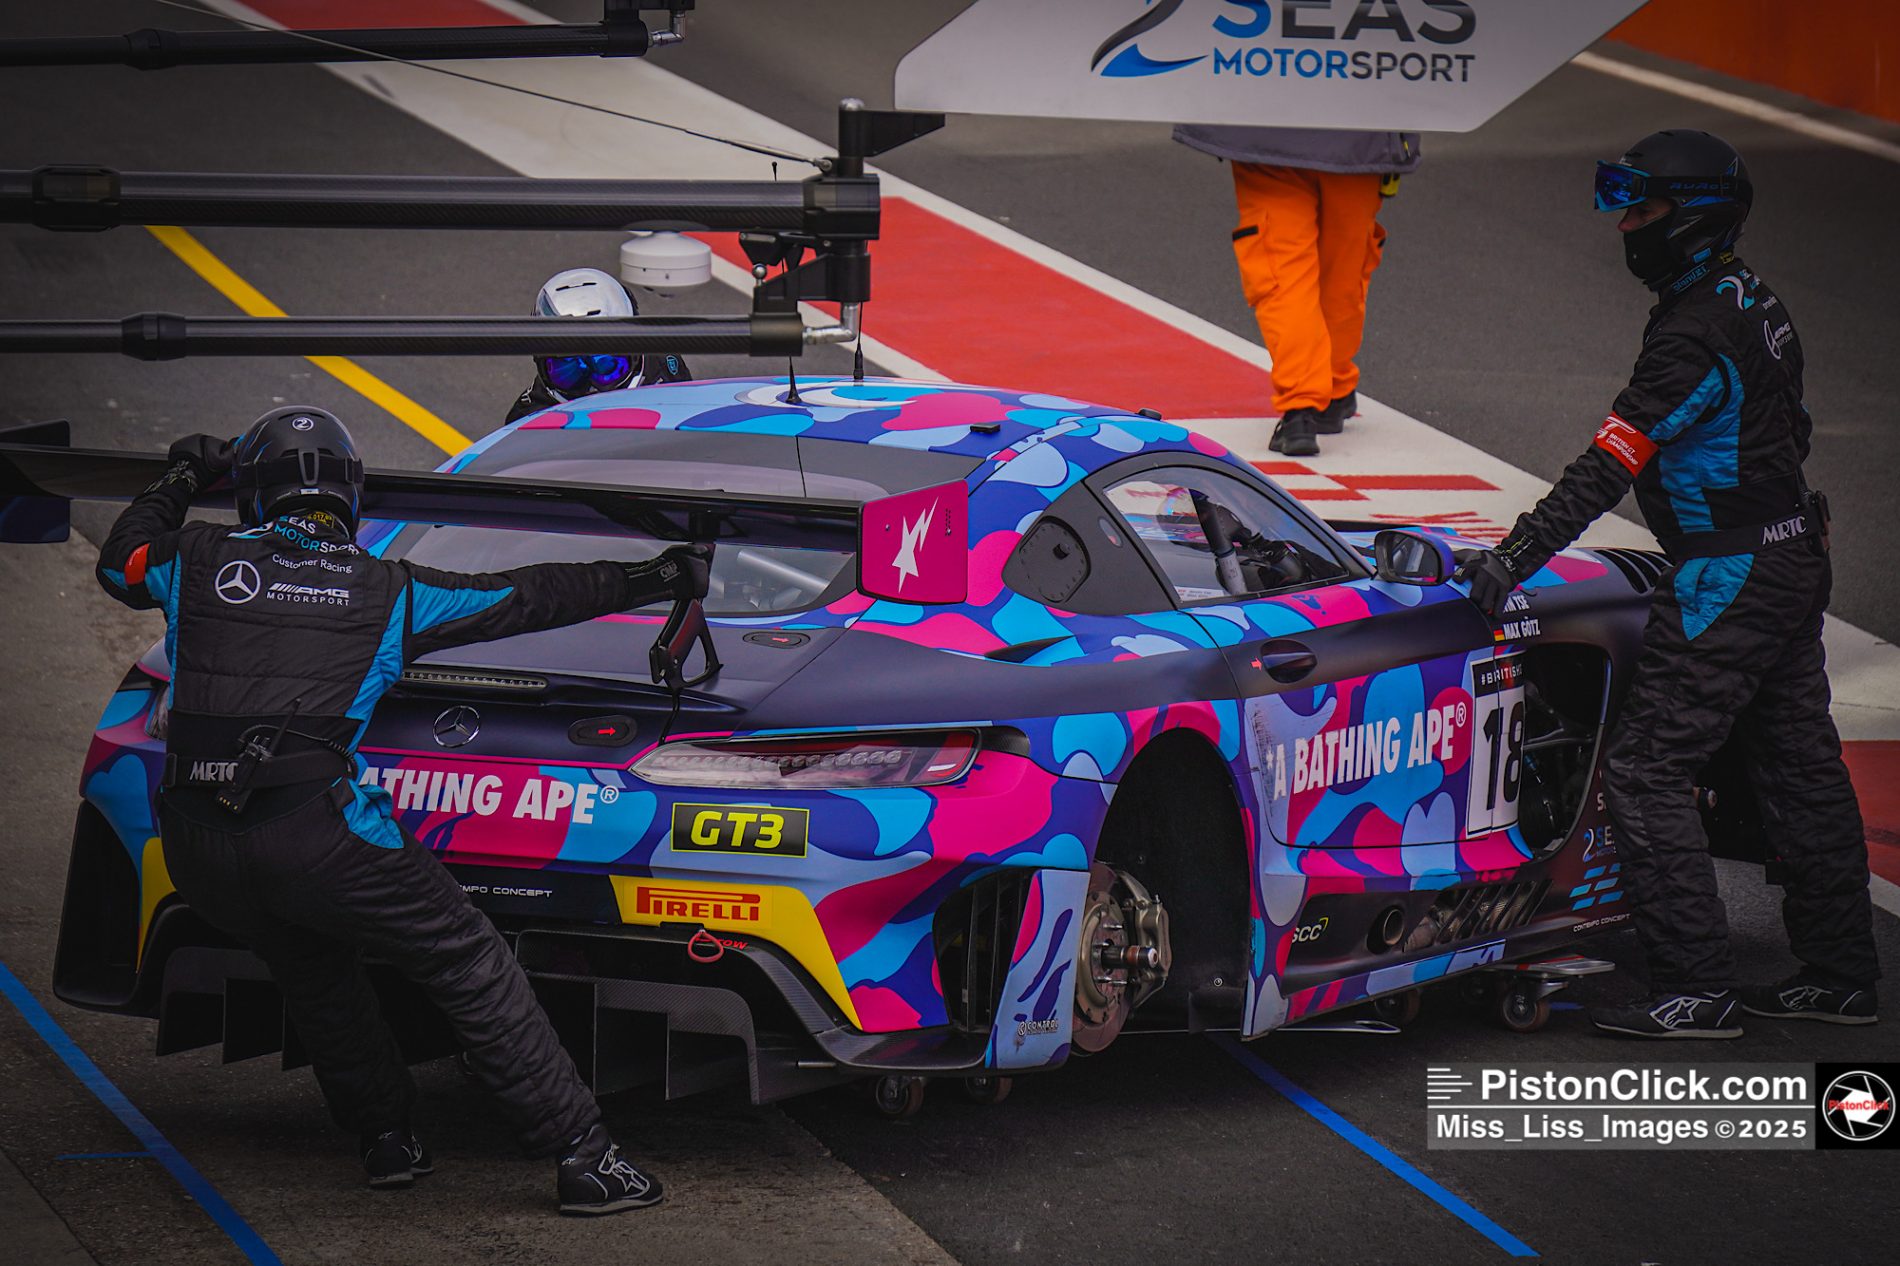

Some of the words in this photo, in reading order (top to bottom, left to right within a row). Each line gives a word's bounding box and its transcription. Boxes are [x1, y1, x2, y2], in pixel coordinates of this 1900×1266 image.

[1212, 0, 1476, 44] SEAS
[1213, 47, 1476, 82] MOTORSPORT
[1762, 516, 1806, 545] MRTC
[272, 553, 317, 570] Customer
[320, 558, 352, 574] Racing
[266, 592, 349, 606] MOTORSPORT
[1512, 594, 1530, 610] TSE
[1503, 621, 1521, 640] MAX
[1294, 717, 1401, 795] BATHING
[1483, 701, 1524, 811] 18
[189, 761, 239, 781] MRTC
[358, 766, 503, 817] ATHING
[690, 810, 785, 849] GT3
[460, 884, 488, 894] MPO
[492, 887, 553, 898] CONCEPT
[636, 886, 761, 921] PIRELLI
[1600, 913, 1631, 925] CONCEPT
